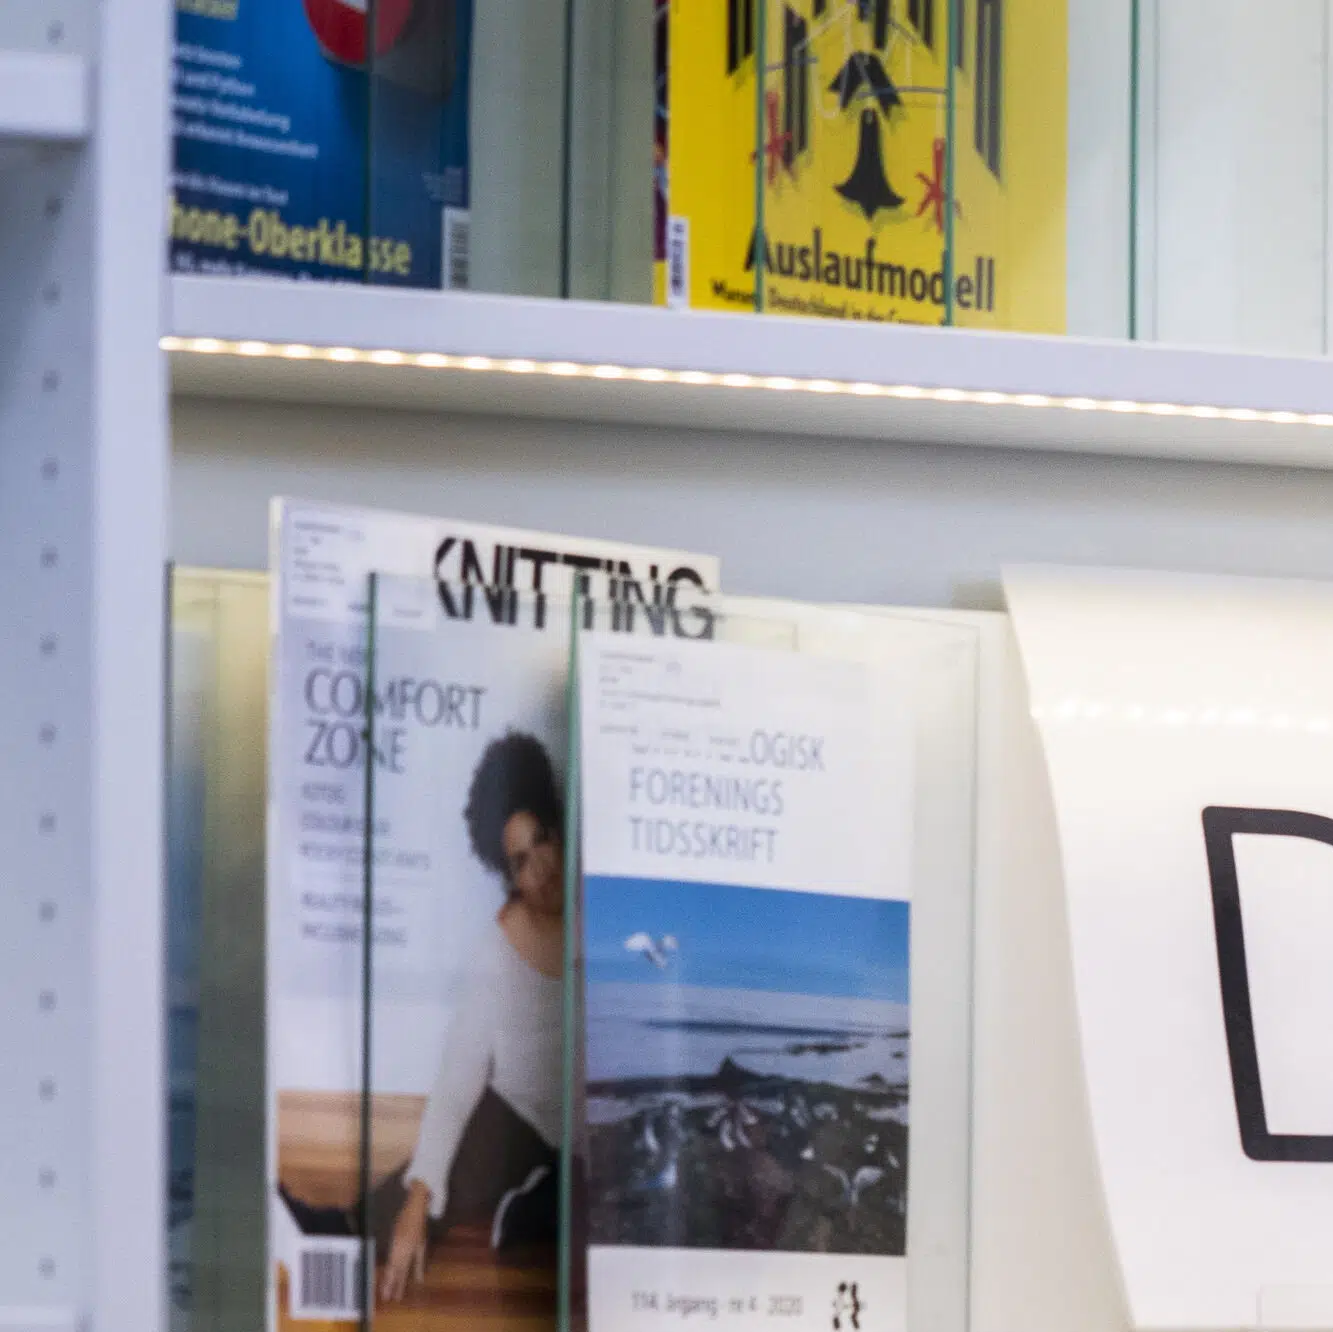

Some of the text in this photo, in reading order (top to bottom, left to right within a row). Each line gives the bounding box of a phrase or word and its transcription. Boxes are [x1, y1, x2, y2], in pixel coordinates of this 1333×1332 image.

[744, 226, 995, 312] Auslaufmodell
[304, 667, 488, 731] COMFORT
[303, 718, 407, 775] ZONE
[742, 728, 825, 772] OGISK
[629, 766, 784, 817] FORENINGS
[629, 816, 779, 864] TIDSSKRIFT
